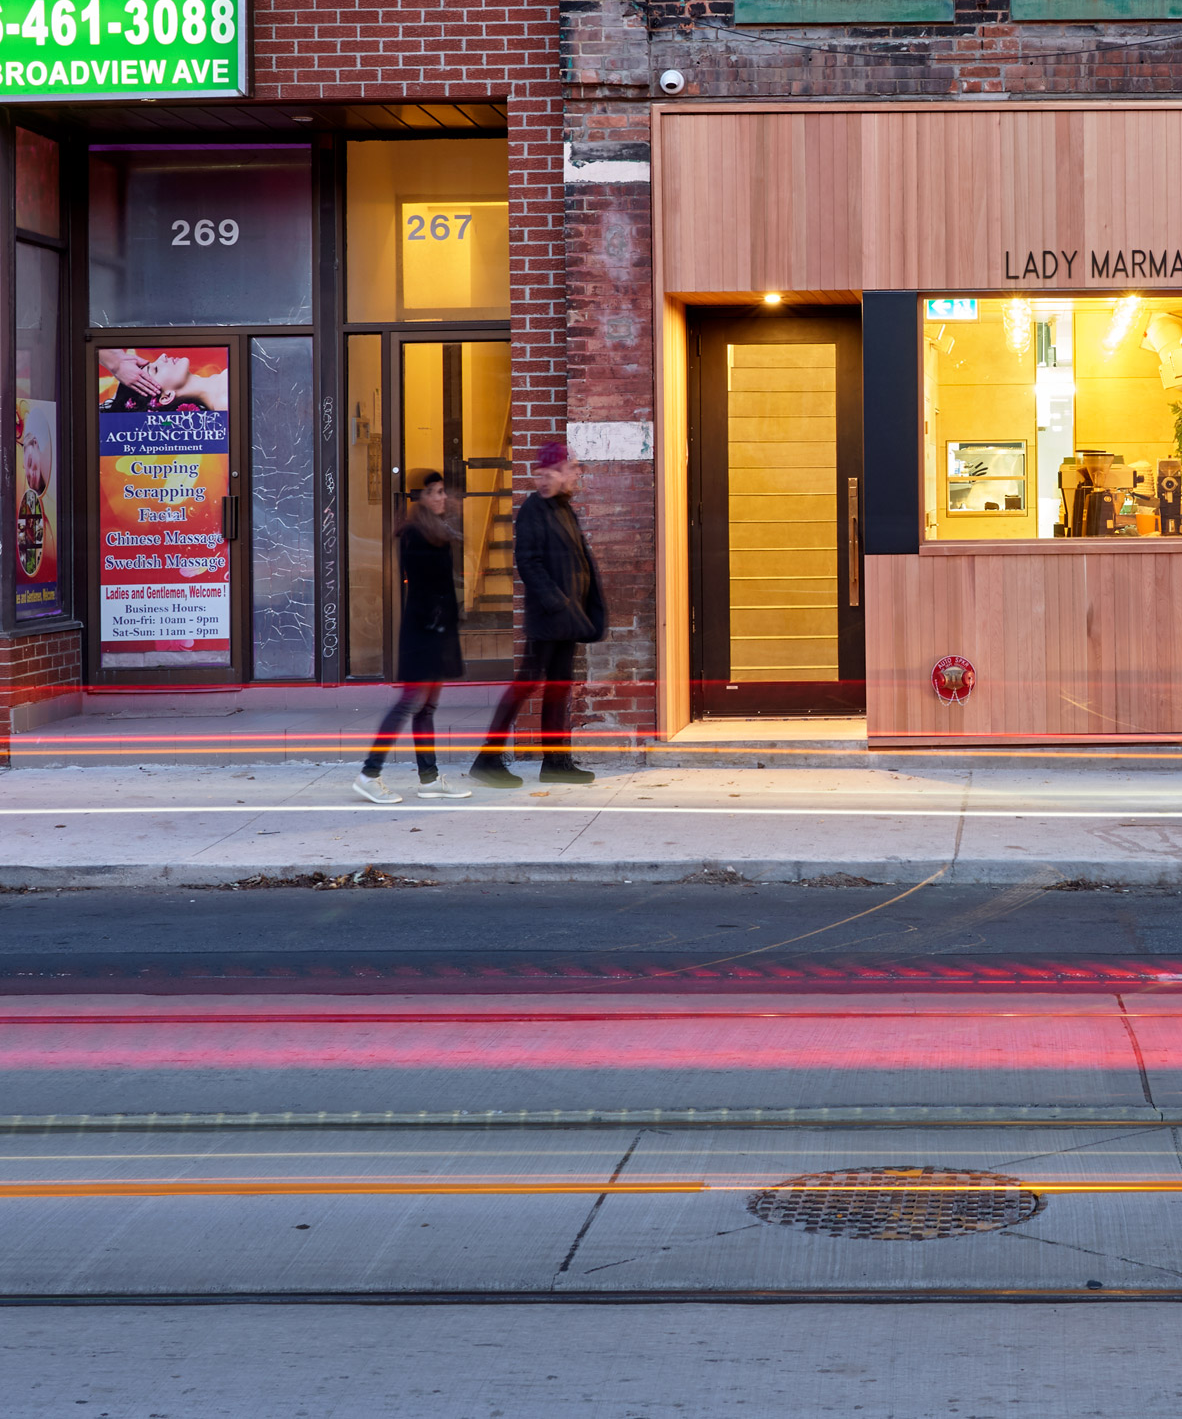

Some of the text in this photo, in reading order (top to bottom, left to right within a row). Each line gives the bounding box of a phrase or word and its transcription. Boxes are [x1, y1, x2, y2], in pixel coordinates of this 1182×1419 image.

[0, 59, 229, 86] ROADVIEW AVE
[171, 219, 240, 246] 269
[407, 214, 473, 241] 267
[1005, 250, 1078, 280] LADY
[106, 430, 225, 443] ACUPUNCTURE
[123, 444, 203, 455] By Appointment
[130, 460, 199, 480] Cupping
[123, 484, 206, 504] Scrapping
[137, 507, 188, 523] Facial
[106, 530, 225, 550] Chinese Massage
[104, 553, 226, 572] Swedish Massage
[105, 587, 129, 601] Ladies
[131, 586, 145, 600] and
[146, 586, 188, 601] Gentlemen,
[125, 603, 207, 614] Business Hours:
[112, 616, 156, 626] Mon-fri:
[159, 616, 187, 625] 10am
[196, 615, 219, 627] 9pm
[112, 628, 156, 638] Sat-Sun:
[159, 628, 186, 636] 11am
[196, 627, 219, 639] 9pm
